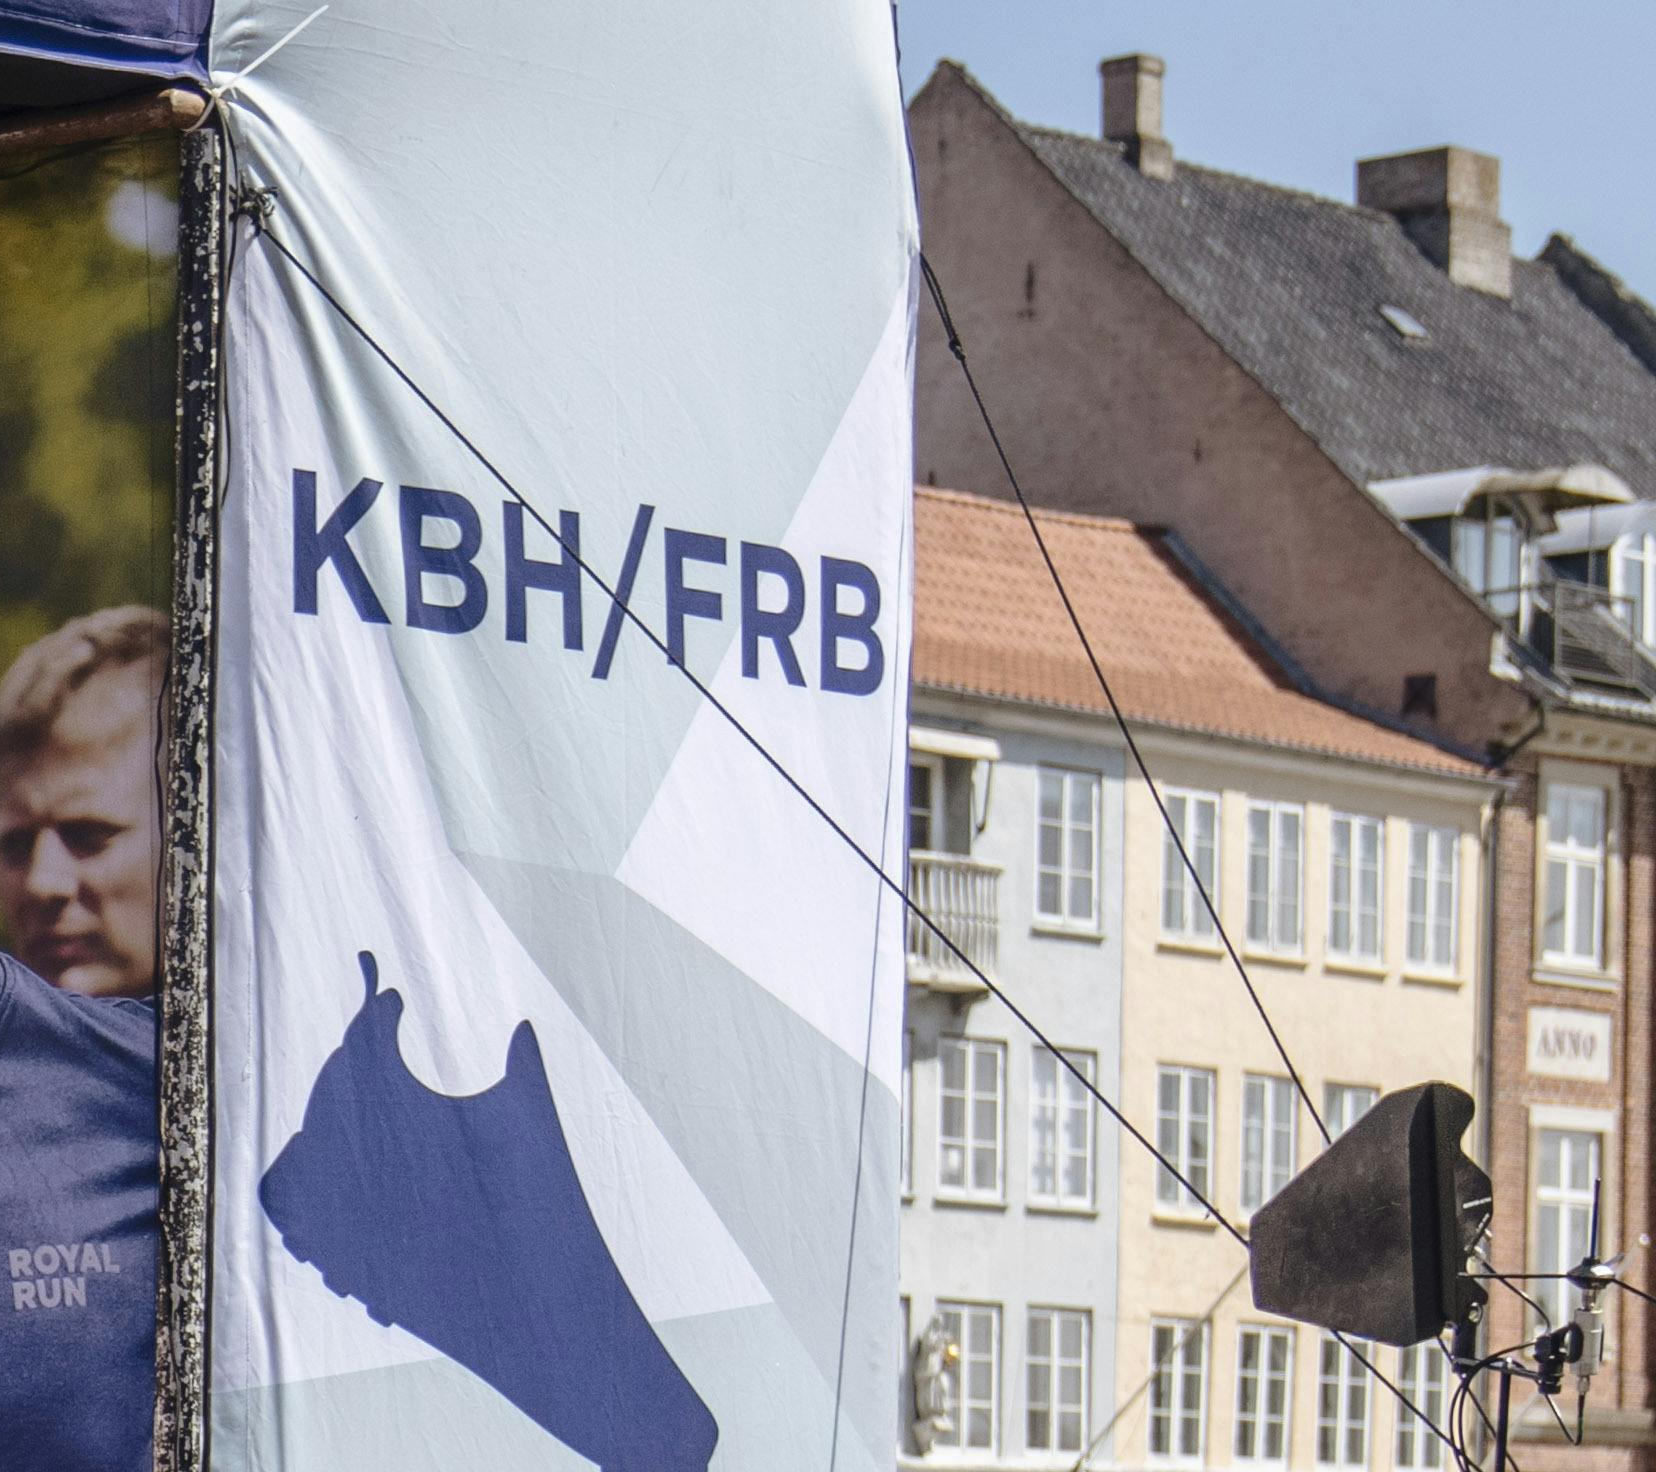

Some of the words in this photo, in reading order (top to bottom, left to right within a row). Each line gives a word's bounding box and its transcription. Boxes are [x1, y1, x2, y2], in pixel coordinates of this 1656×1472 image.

[291, 468, 886, 698] KBH/FRB
[1536, 1028, 1598, 1062] ANNO
[9, 1242, 120, 1277] ROYAL
[12, 1276, 87, 1310] RUN
